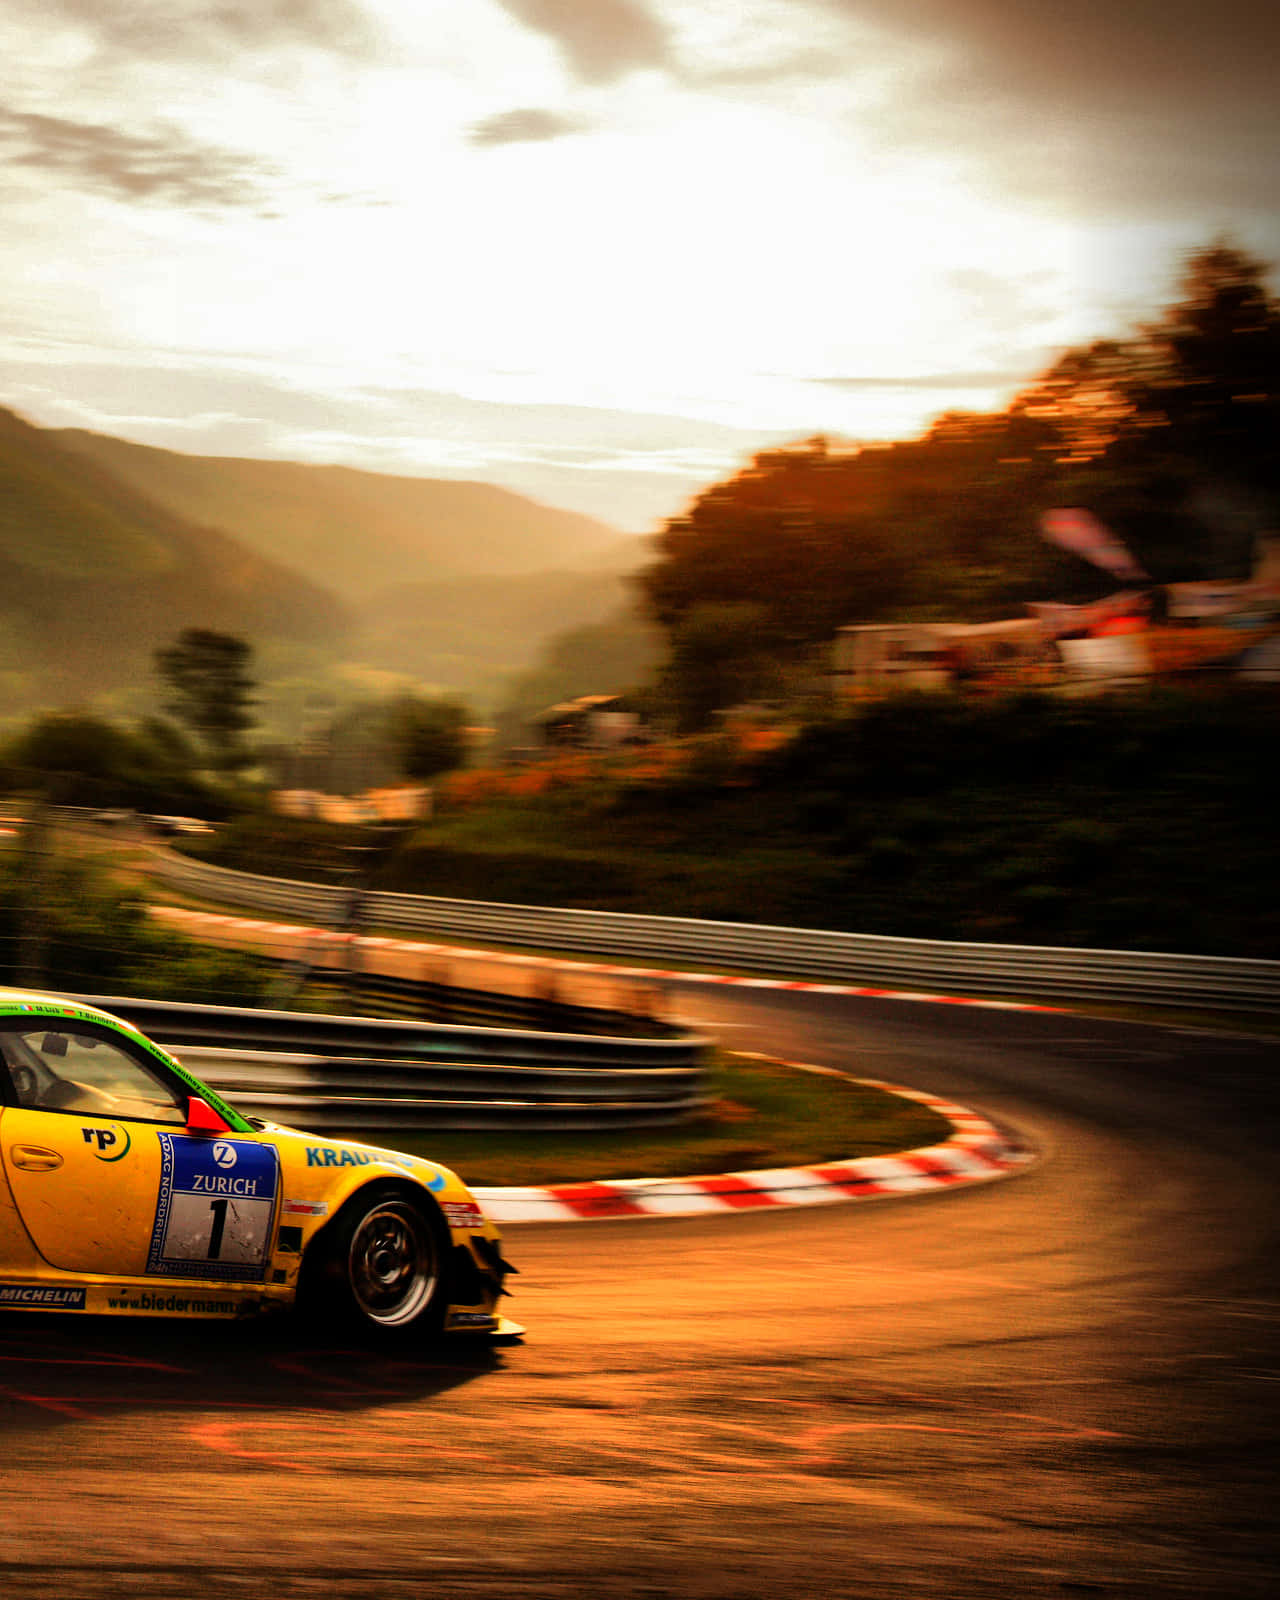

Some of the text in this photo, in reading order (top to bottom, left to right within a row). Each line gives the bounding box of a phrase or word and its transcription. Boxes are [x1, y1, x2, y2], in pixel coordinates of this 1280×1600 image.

[81, 1128, 116, 1150] rp
[159, 1134, 171, 1173] ADAC
[305, 1147, 397, 1168] KRAU
[192, 1174, 257, 1196] ZURICH
[208, 1199, 228, 1260] 1
[0, 1288, 82, 1303] MICHELIN
